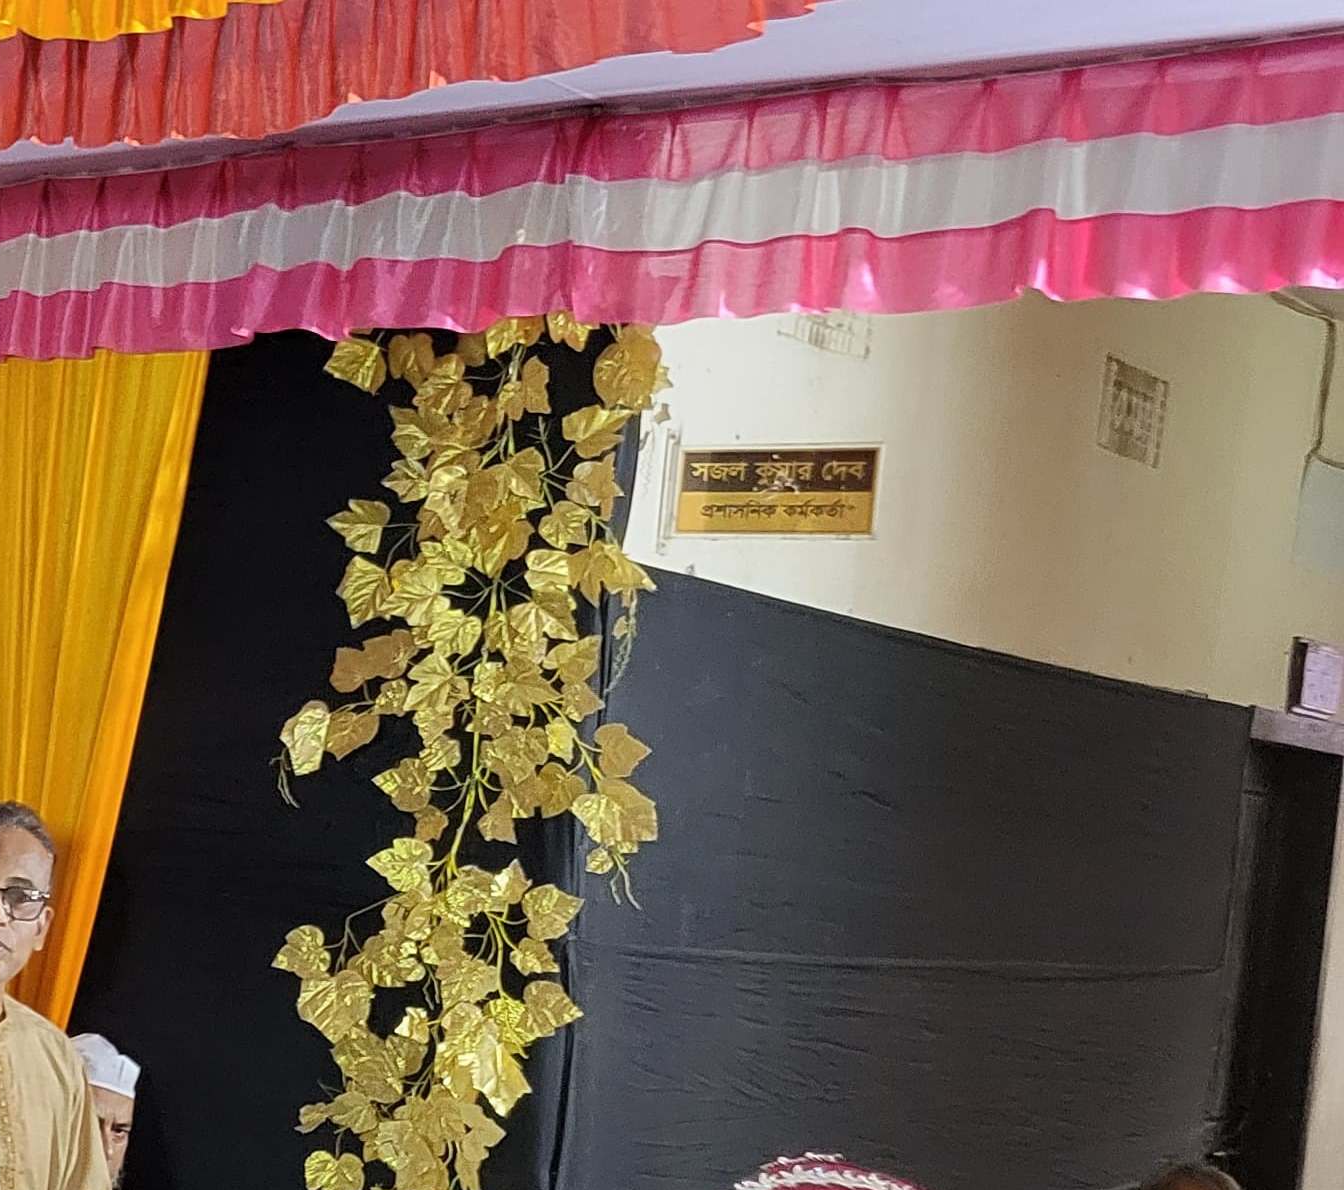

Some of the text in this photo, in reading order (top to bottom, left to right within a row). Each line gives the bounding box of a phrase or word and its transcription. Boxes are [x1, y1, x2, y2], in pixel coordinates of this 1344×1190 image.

[689, 461, 747, 483] সজল
[821, 460, 866, 481] দেব
[699, 499, 846, 519] প্রশাসনিক কর্মকর্তা
